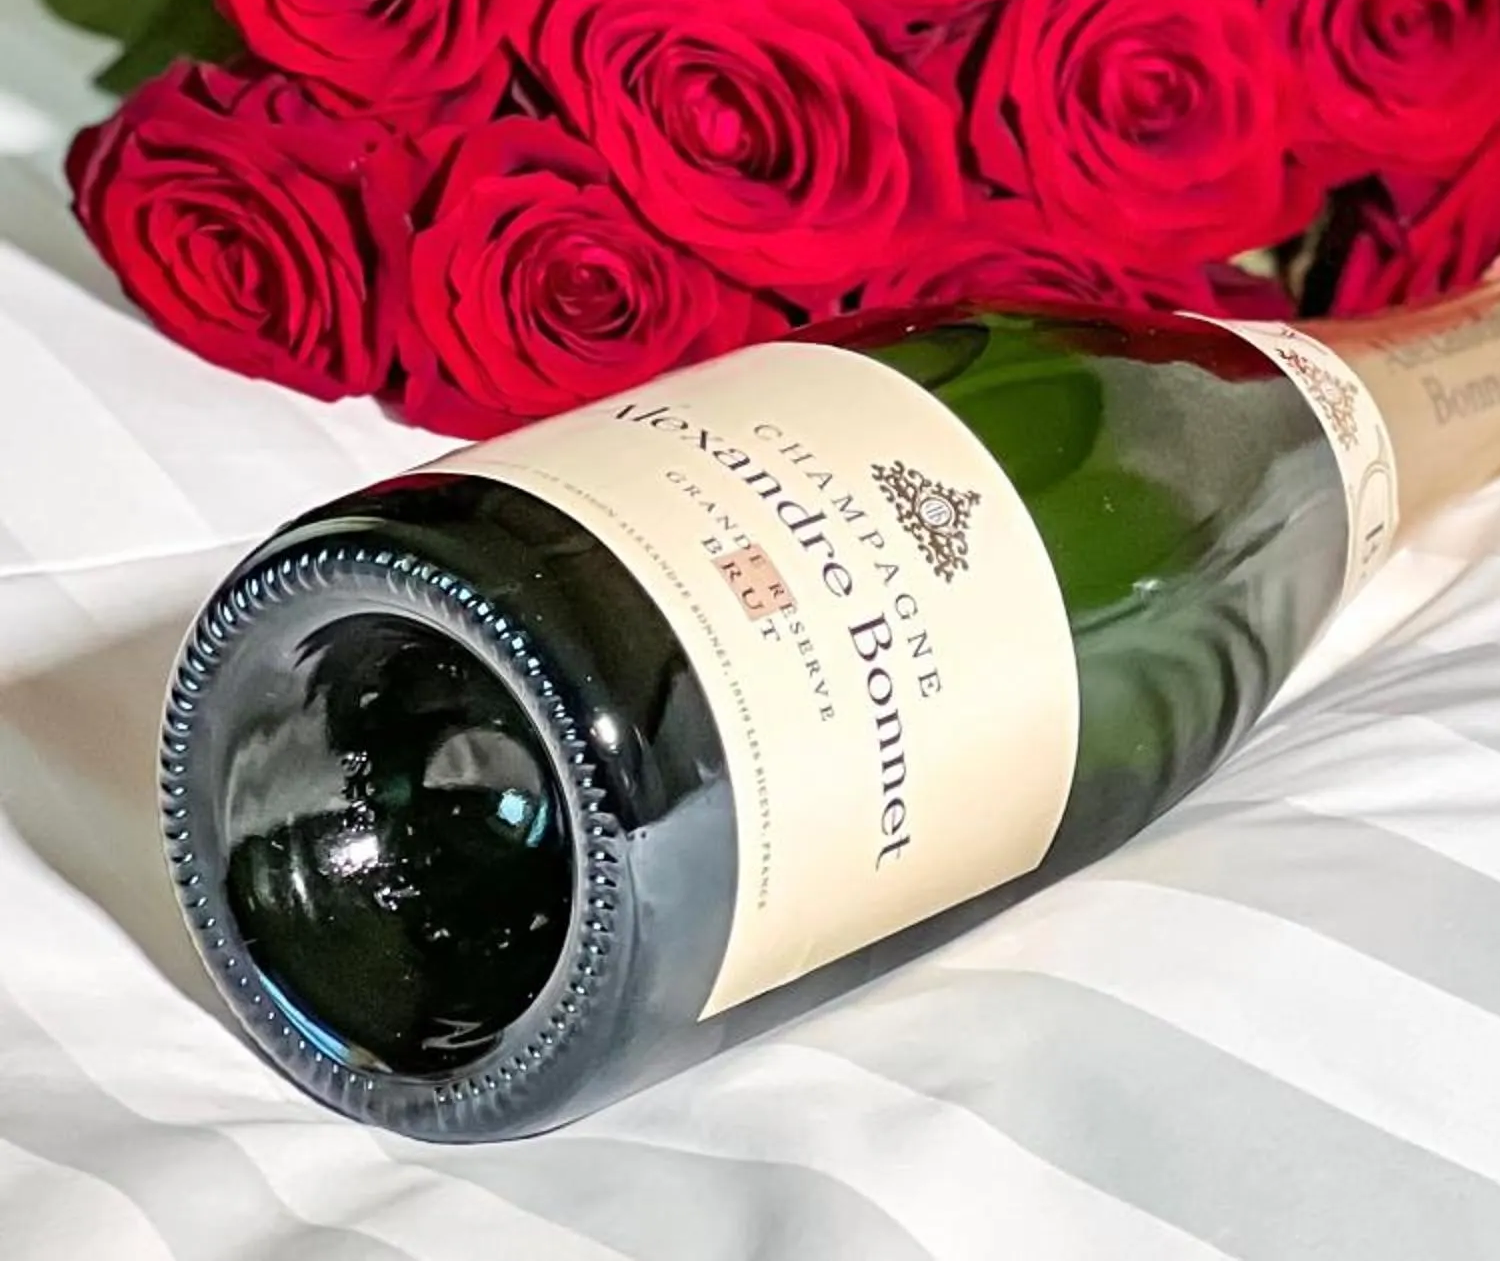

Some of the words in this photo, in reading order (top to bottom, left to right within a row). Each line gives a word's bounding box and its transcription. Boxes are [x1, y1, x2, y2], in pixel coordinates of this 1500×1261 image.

[665, 470, 767, 569] GRANDE
[768, 582, 835, 721] RESERVE
[701, 537, 780, 643] BRUT
[754, 423, 942, 698] CHAMPAGNE
[848, 612, 911, 871] Bonnet
